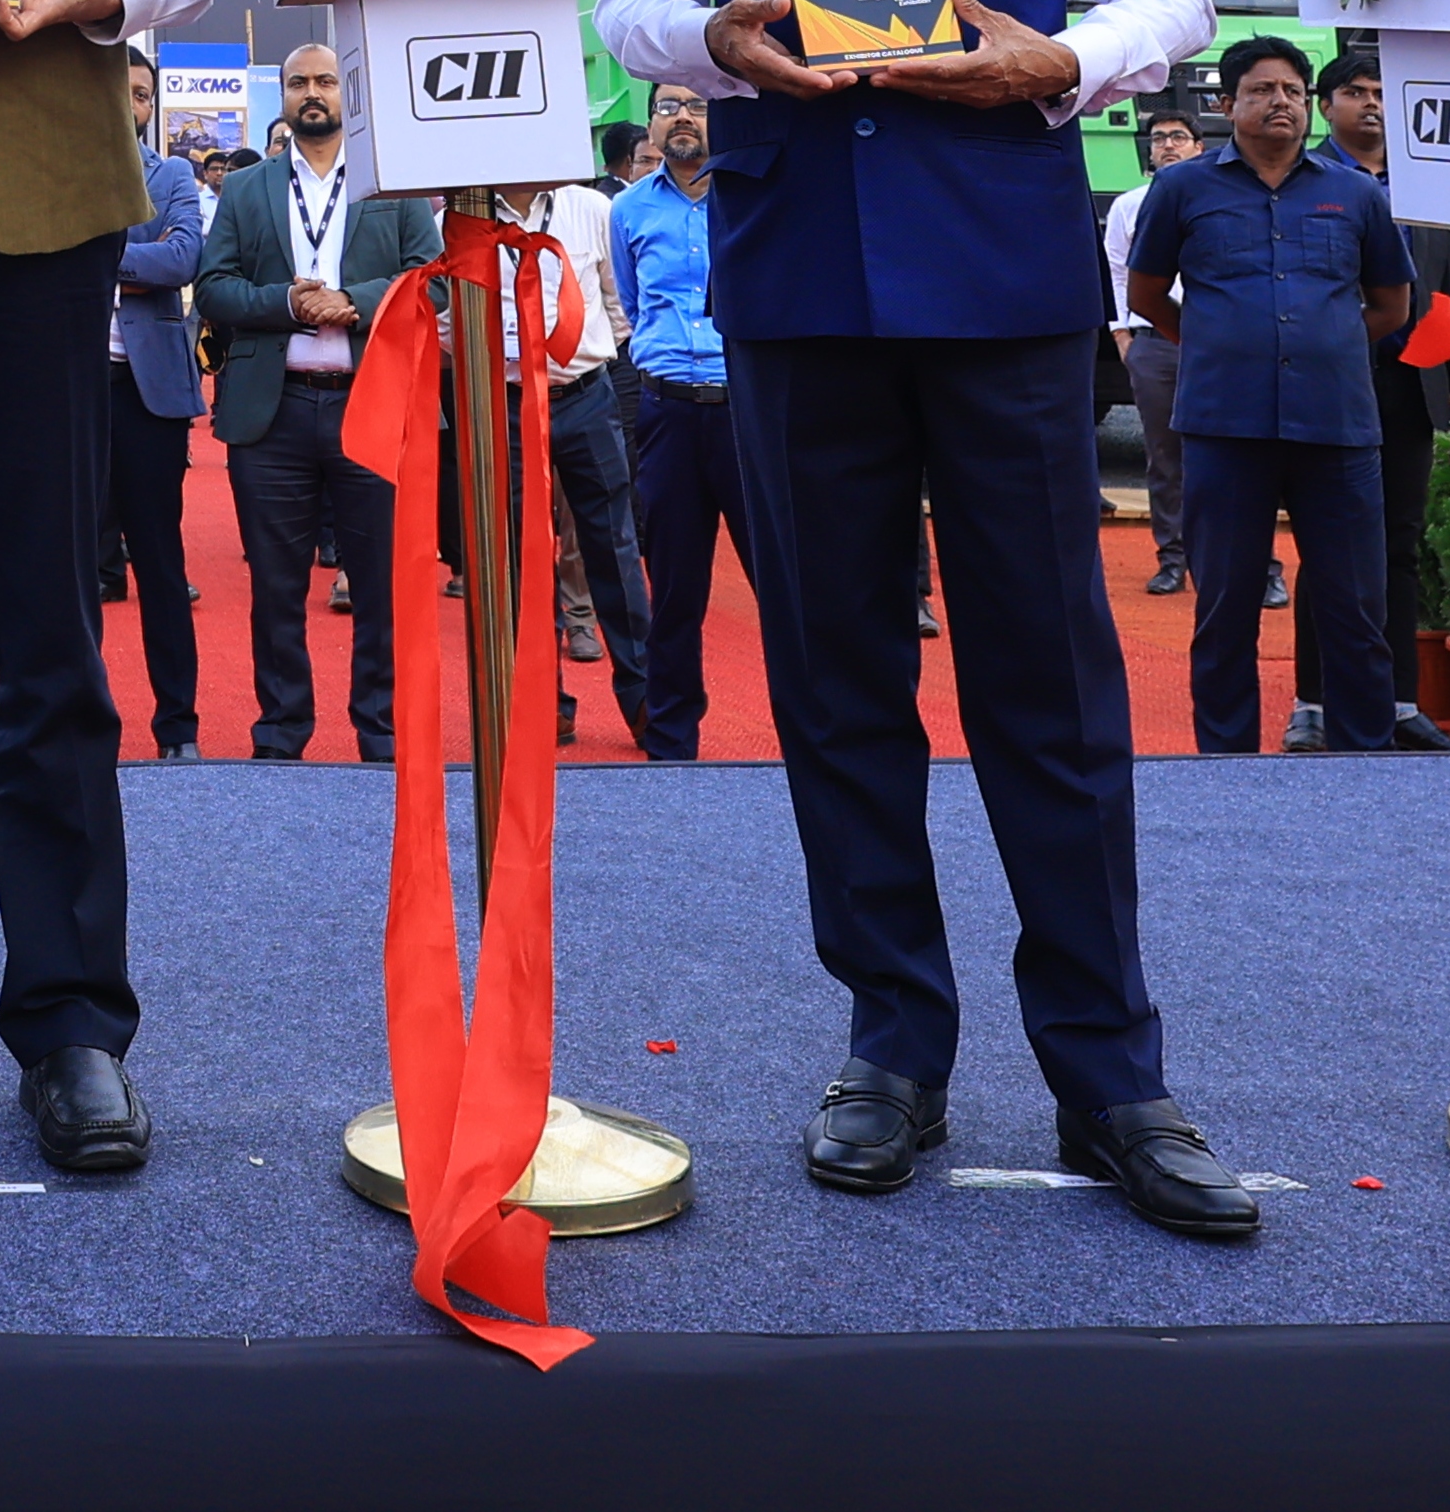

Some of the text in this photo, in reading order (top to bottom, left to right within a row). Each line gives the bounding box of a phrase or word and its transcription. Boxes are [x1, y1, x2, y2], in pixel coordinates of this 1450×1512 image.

[844, 47, 924, 60] EXHIBITOR CATALOGUE
[184, 77, 243, 94] XCMG
[346, 66, 361, 119] CII
[423, 49, 530, 102] CII
